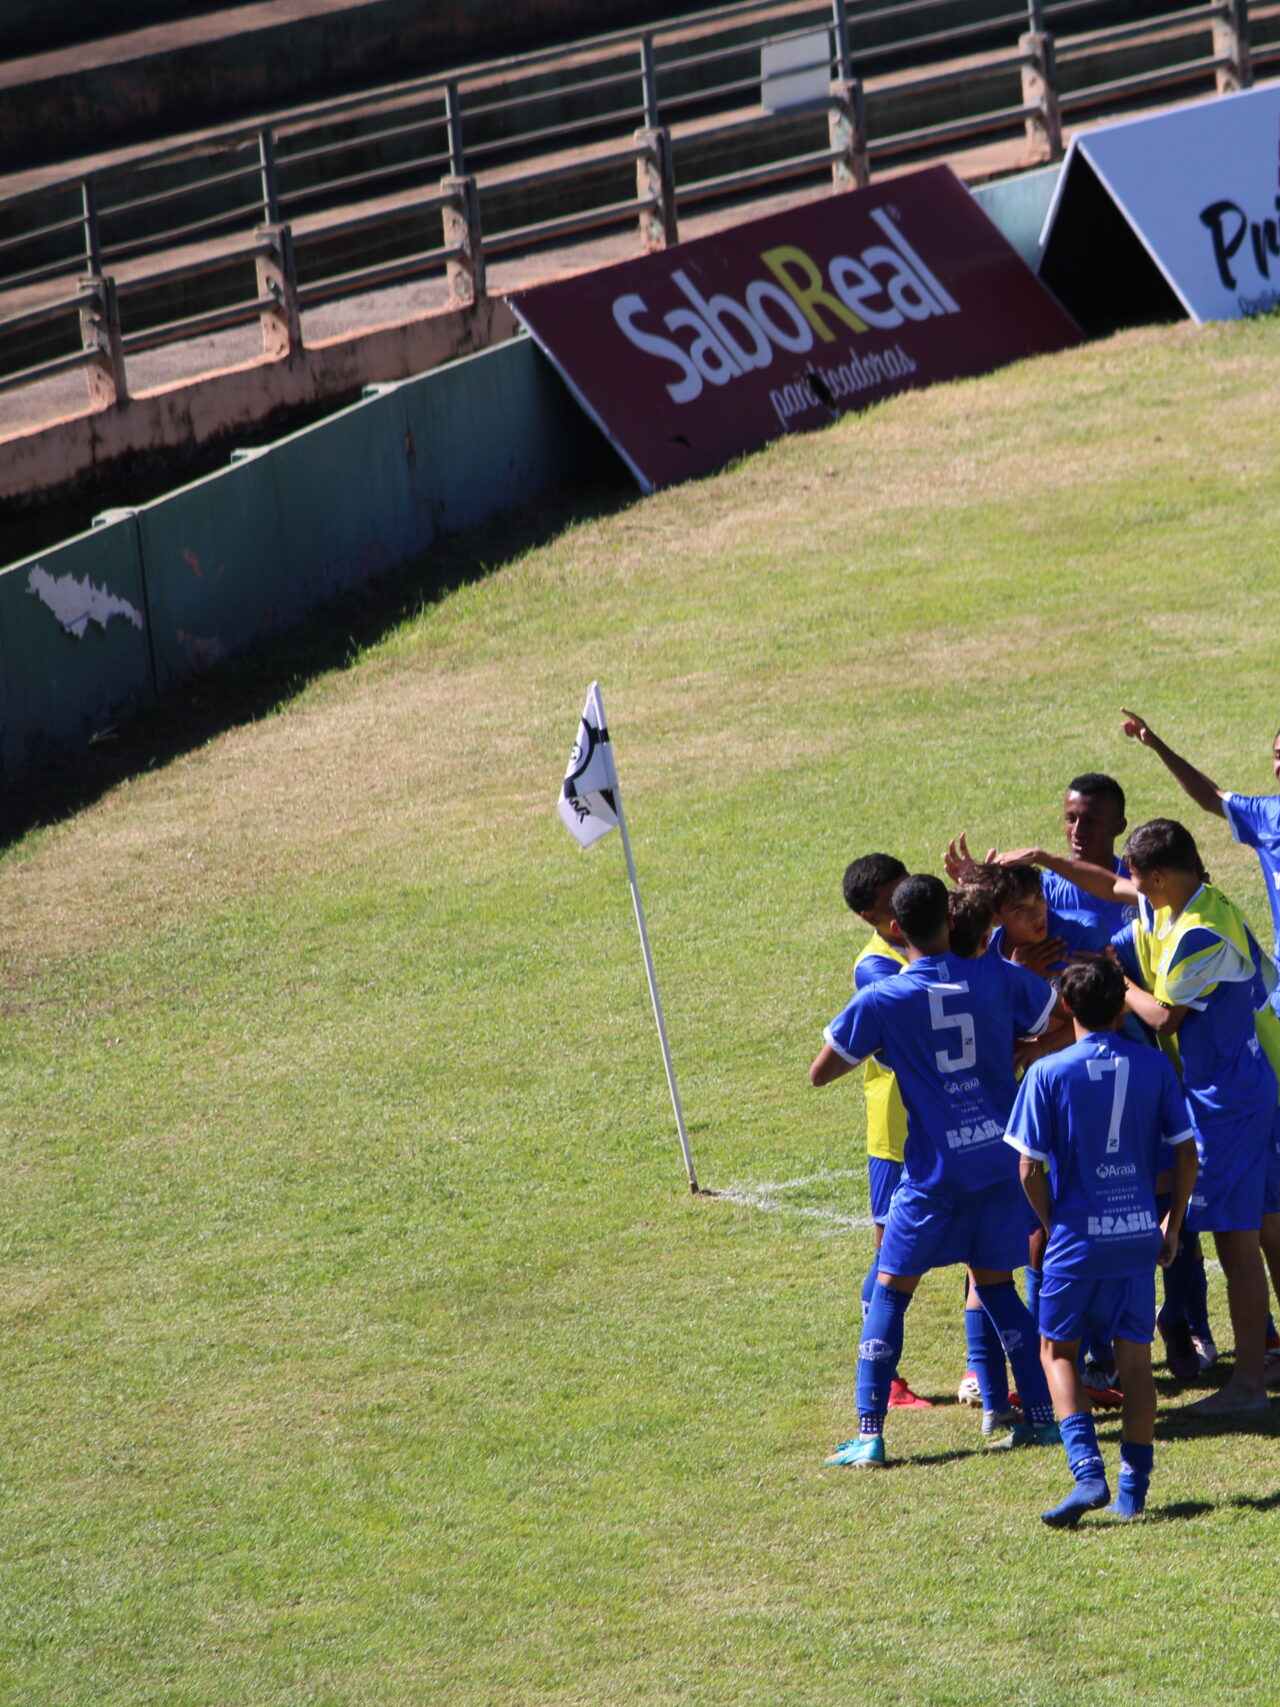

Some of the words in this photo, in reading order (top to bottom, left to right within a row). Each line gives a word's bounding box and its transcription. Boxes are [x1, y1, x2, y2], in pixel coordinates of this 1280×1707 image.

[612, 206, 961, 404] SaboReal
[927, 980, 977, 1073] 5
[1086, 1056, 1130, 1154] 7
[1087, 1210, 1157, 1235] BRASIL
